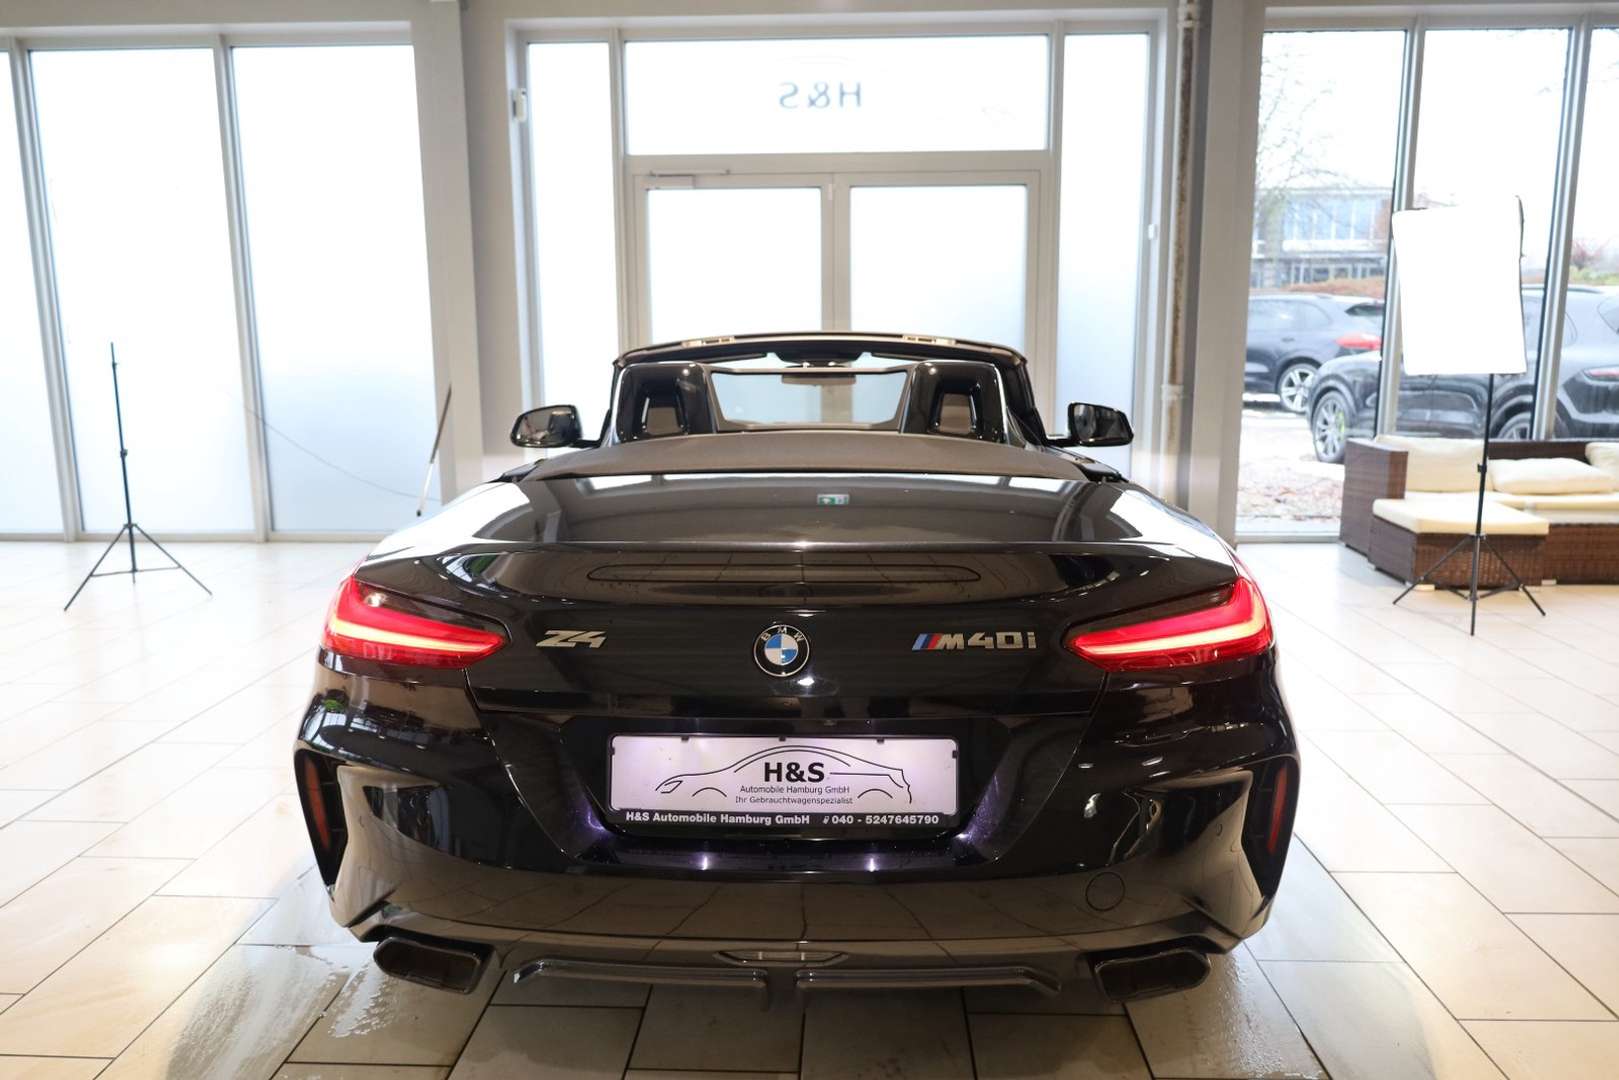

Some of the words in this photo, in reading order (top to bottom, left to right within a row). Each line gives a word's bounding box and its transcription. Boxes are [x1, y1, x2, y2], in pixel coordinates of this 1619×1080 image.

[535, 630, 606, 648] Z4
[760, 626, 805, 642] BMW
[935, 631, 1037, 650] M40i
[764, 762, 825, 783] H&S
[740, 785, 785, 794] Automobile
[786, 785, 823, 795] Hamburg
[825, 786, 850, 794] GmbH
[735, 796, 747, 804] Ihr
[749, 796, 854, 806] Gebrauchtwagenspezialist
[626, 811, 650, 822] H&S
[653, 812, 717, 823] Automobile
[720, 813, 772, 826] Hamburg
[775, 814, 810, 824] GmbH
[831, 815, 854, 825] 040
[865, 815, 940, 825] 5247645790
